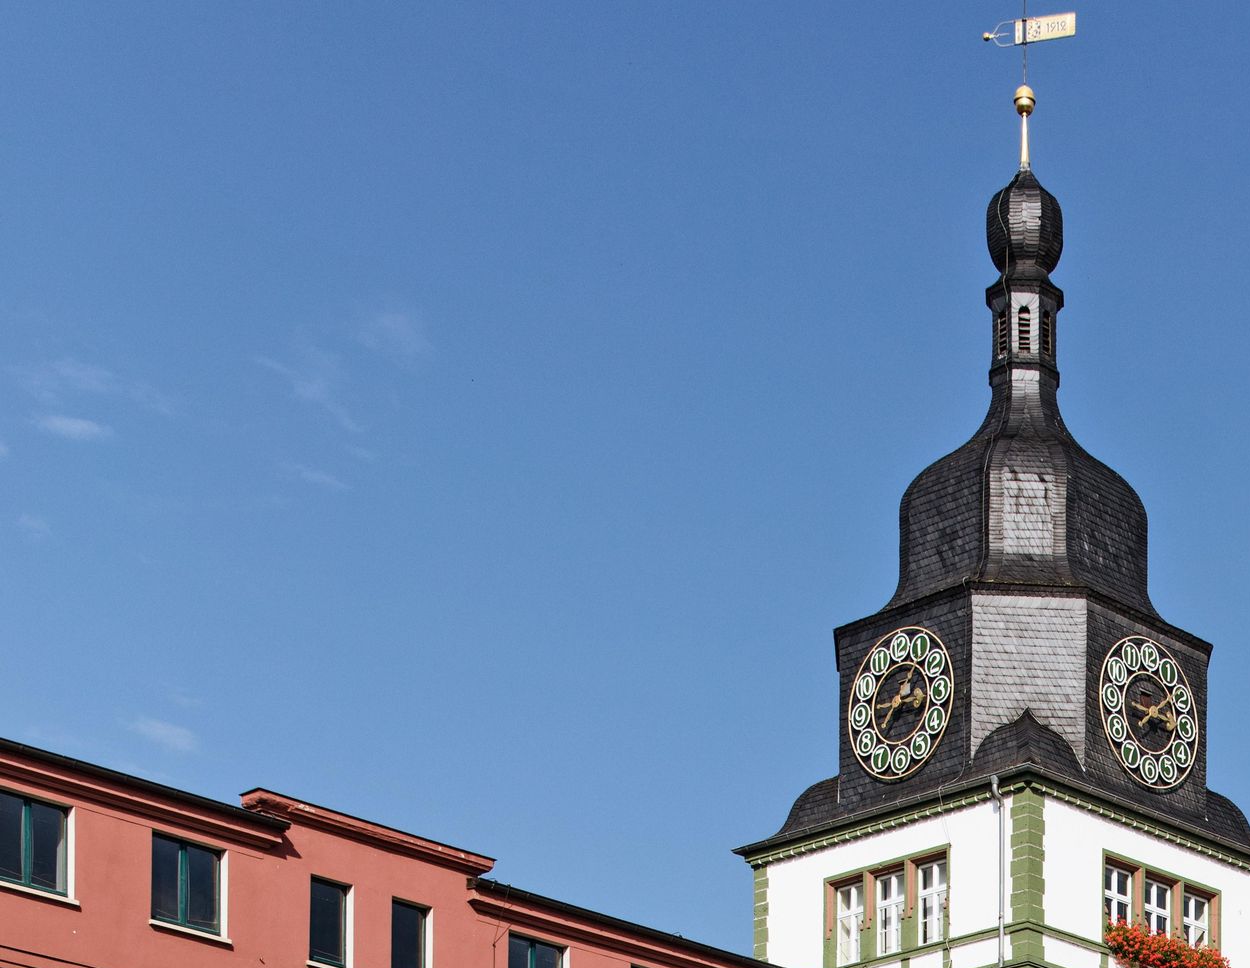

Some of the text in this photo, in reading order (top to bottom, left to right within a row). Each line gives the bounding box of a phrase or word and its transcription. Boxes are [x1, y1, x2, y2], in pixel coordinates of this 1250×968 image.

[893, 637, 906, 658] 12
[1126, 647, 1136, 666] 11
[1144, 646, 1156, 667] 12
[875, 653, 885, 670] 11
[930, 654, 940, 673] 2
[1111, 662, 1124, 681] 10
[860, 678, 872, 696] 10
[935, 680, 945, 699] 3
[1107, 688, 1117, 707] 9
[1177, 689, 1187, 709] 2
[856, 707, 866, 726] 9
[930, 711, 940, 730] 4
[1112, 719, 1122, 737] 8
[1182, 718, 1191, 738] 3
[861, 733, 871, 752] 8
[915, 736, 925, 755] 5
[875, 749, 885, 768] 7
[895, 750, 906, 769] 6
[1126, 745, 1135, 763] 7
[1176, 744, 1186, 763] 4
[1144, 760, 1154, 779] 6
[1163, 760, 1172, 779] 5
